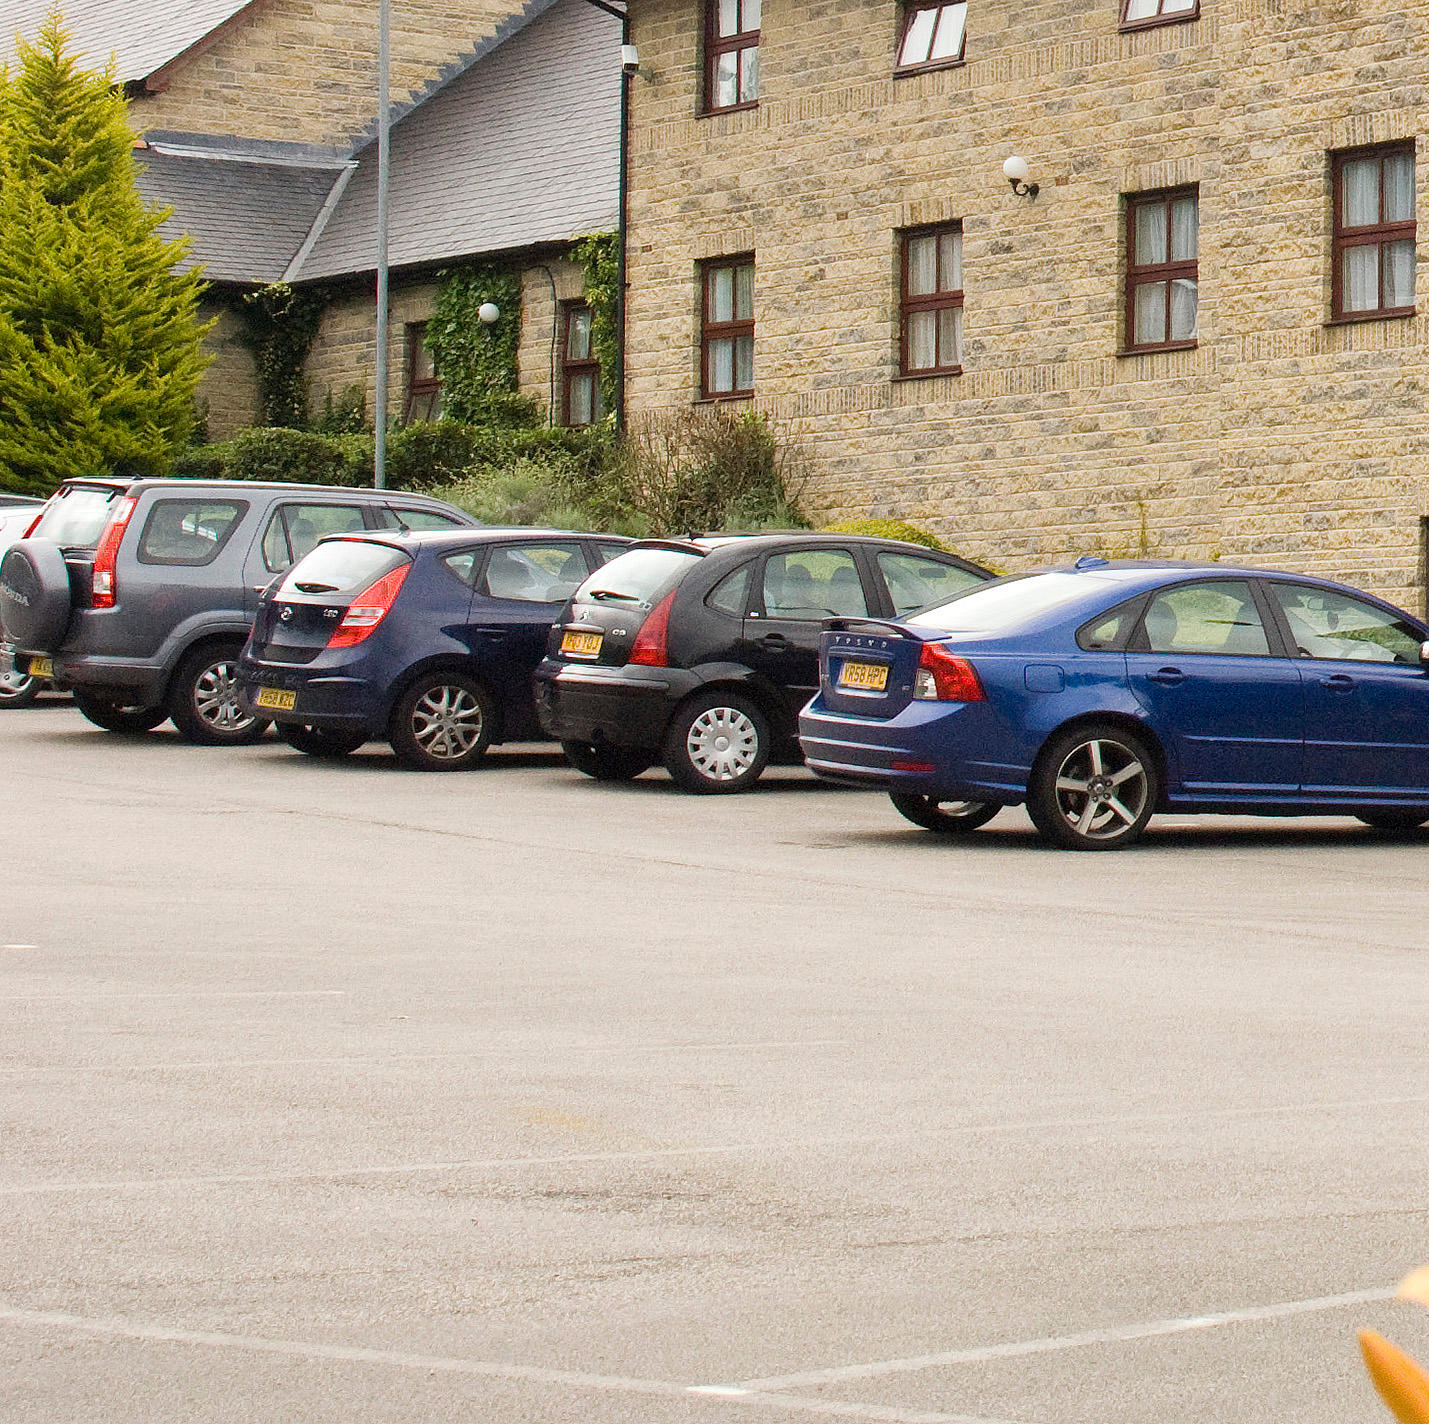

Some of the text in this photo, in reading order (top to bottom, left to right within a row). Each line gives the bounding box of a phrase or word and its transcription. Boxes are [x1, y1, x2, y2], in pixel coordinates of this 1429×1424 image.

[835, 636, 887, 649] VOLVO
[843, 663, 887, 685] YR58 HPC
